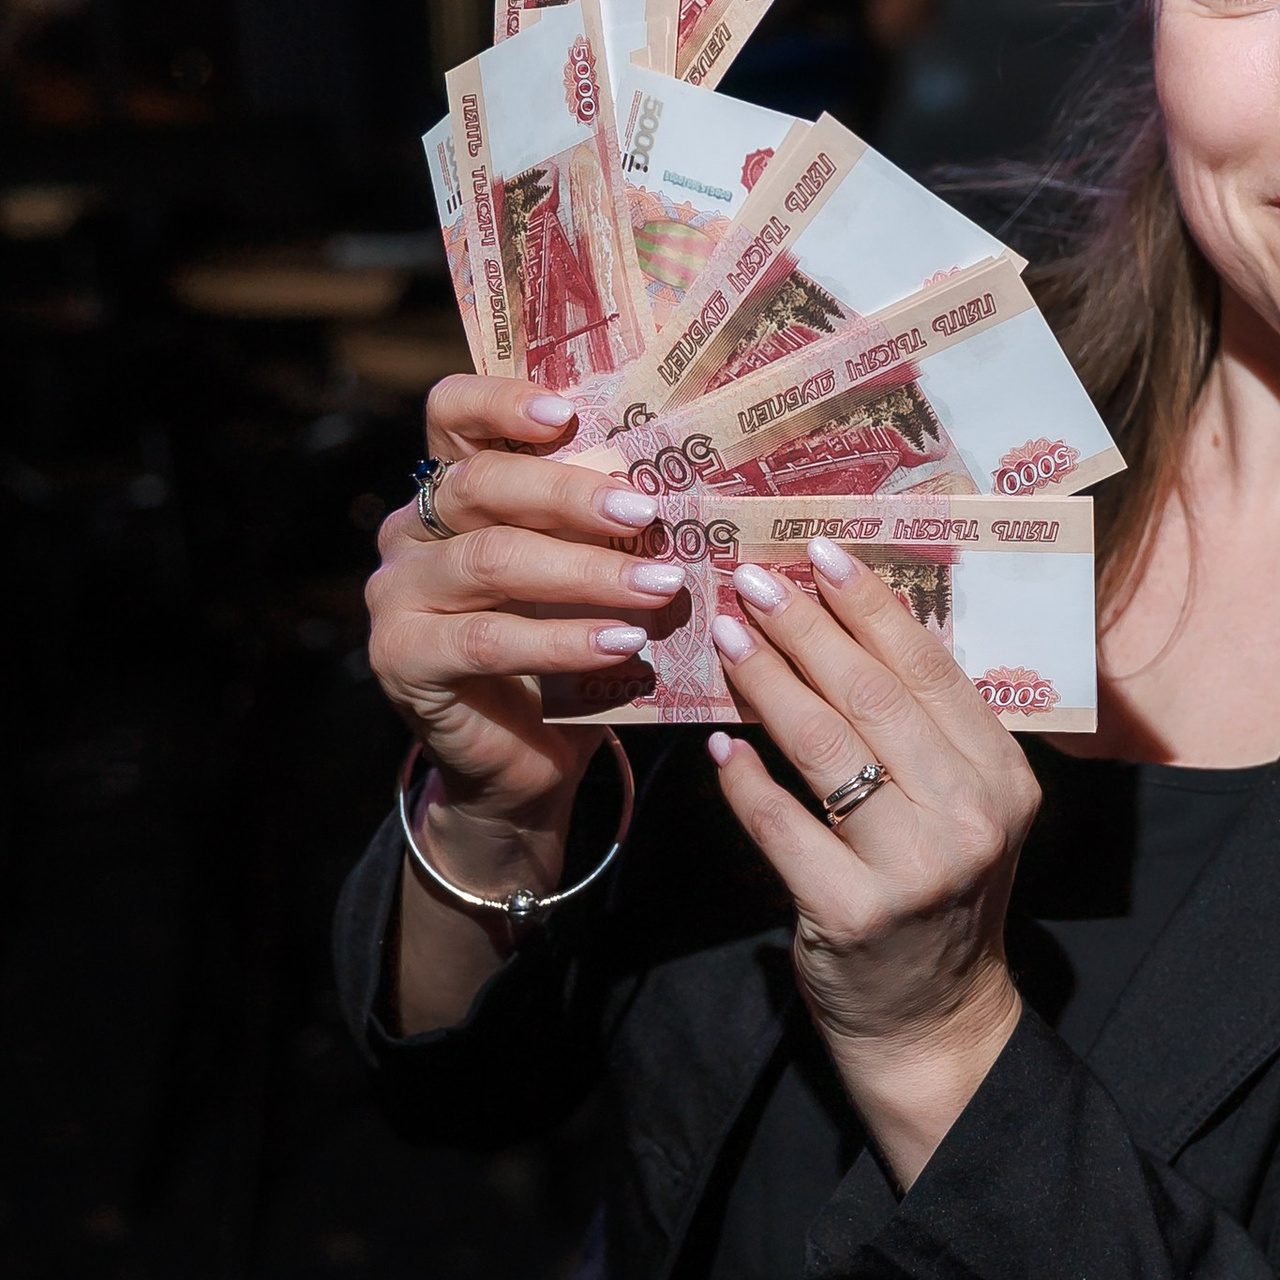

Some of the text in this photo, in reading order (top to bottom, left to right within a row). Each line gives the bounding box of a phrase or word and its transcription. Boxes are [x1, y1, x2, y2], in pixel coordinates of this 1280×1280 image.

[572, 42, 596, 118] 5000
[684, 21, 732, 86] БЛЕЙ
[462, 94, 483, 157] ПЯТЬ
[472, 164, 495, 246] ТЫСЯЧ
[784, 152, 837, 213] ПЯТЬ
[726, 216, 791, 294] ТЫСЯЧ
[932, 292, 998, 337] ПЯТЬ
[844, 328, 927, 382] ТЫСЯЧ
[608, 433, 727, 496] 500
[1002, 446, 1071, 495] 5000
[894, 518, 980, 542] ТЫСЯЧ
[991, 520, 1060, 542] ПЯТЬ
[979, 684, 1052, 707] 5000
